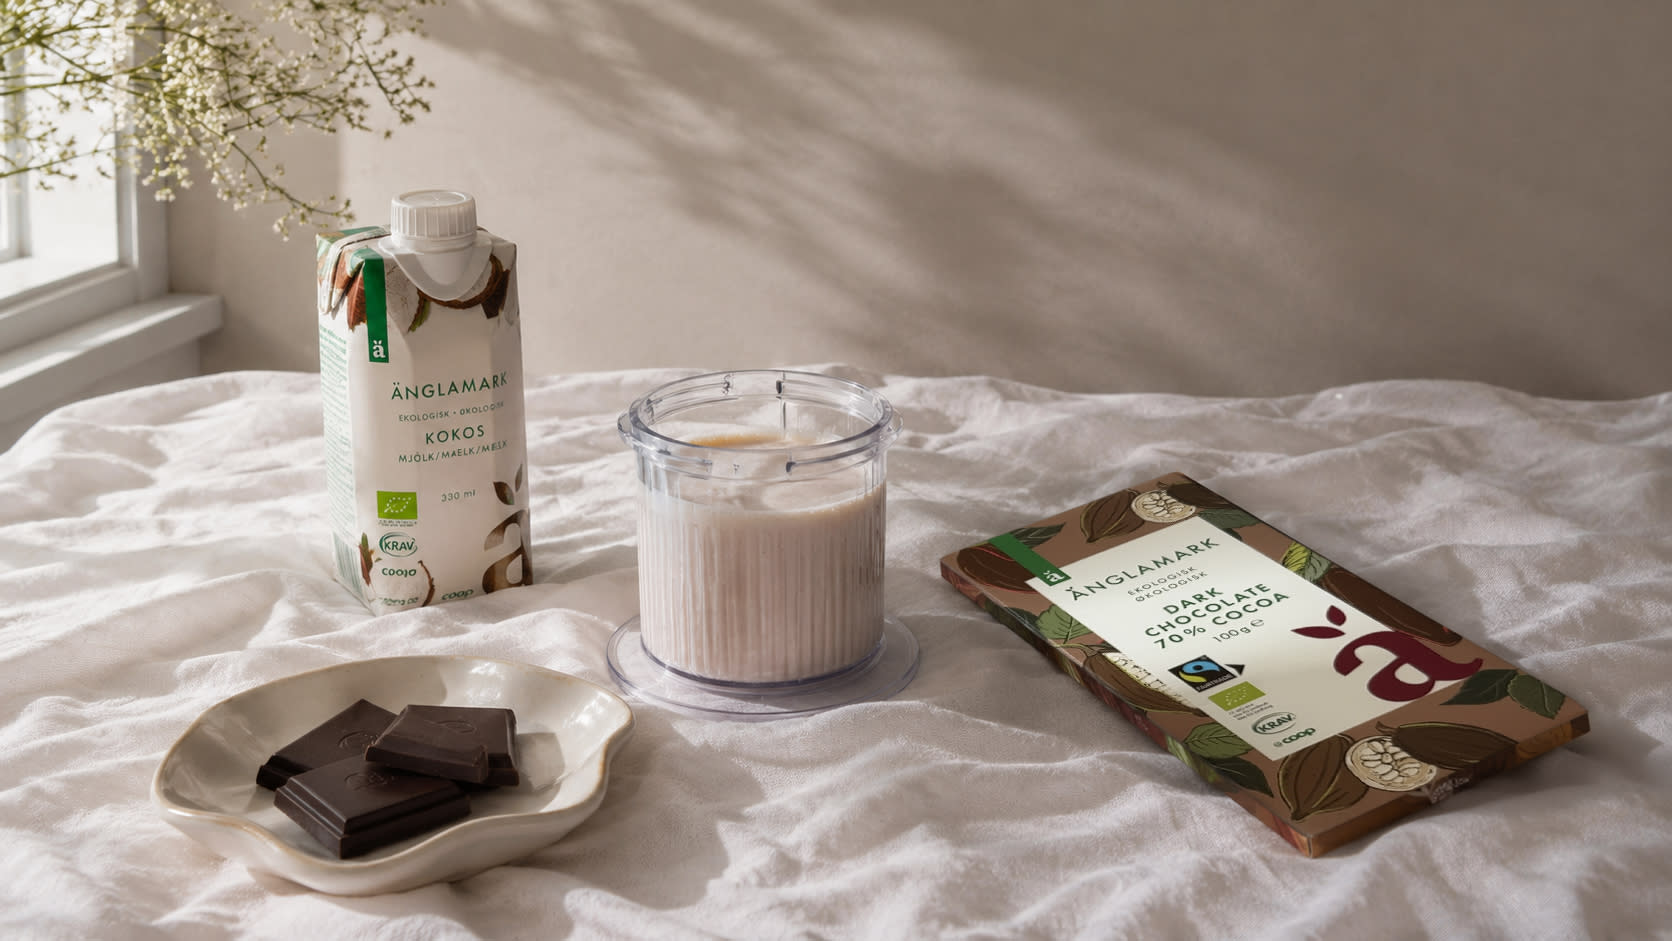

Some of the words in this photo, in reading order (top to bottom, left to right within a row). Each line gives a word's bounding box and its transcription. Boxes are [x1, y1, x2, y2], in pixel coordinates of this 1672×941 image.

[372, 340, 386, 358] ä
[391, 371, 508, 400] ÄNGLAMARK
[398, 411, 449, 422] EKOLOGISK
[425, 425, 485, 444] KOKOS
[441, 492, 460, 502] 330
[464, 490, 476, 498] ml
[384, 541, 414, 551] KRAV
[1065, 538, 1220, 602] ÄNGLAMARK
[1127, 566, 1198, 596] EKOLOGISK
[1135, 571, 1208, 602] ØKOLOGISK
[442, 589, 474, 600] coop
[1163, 587, 1224, 615] DARK
[1145, 583, 1271, 637] CHOCOLATE
[1212, 592, 1290, 626] COCOA
[1258, 714, 1292, 732] KRAV
[1282, 728, 1316, 743] coop
